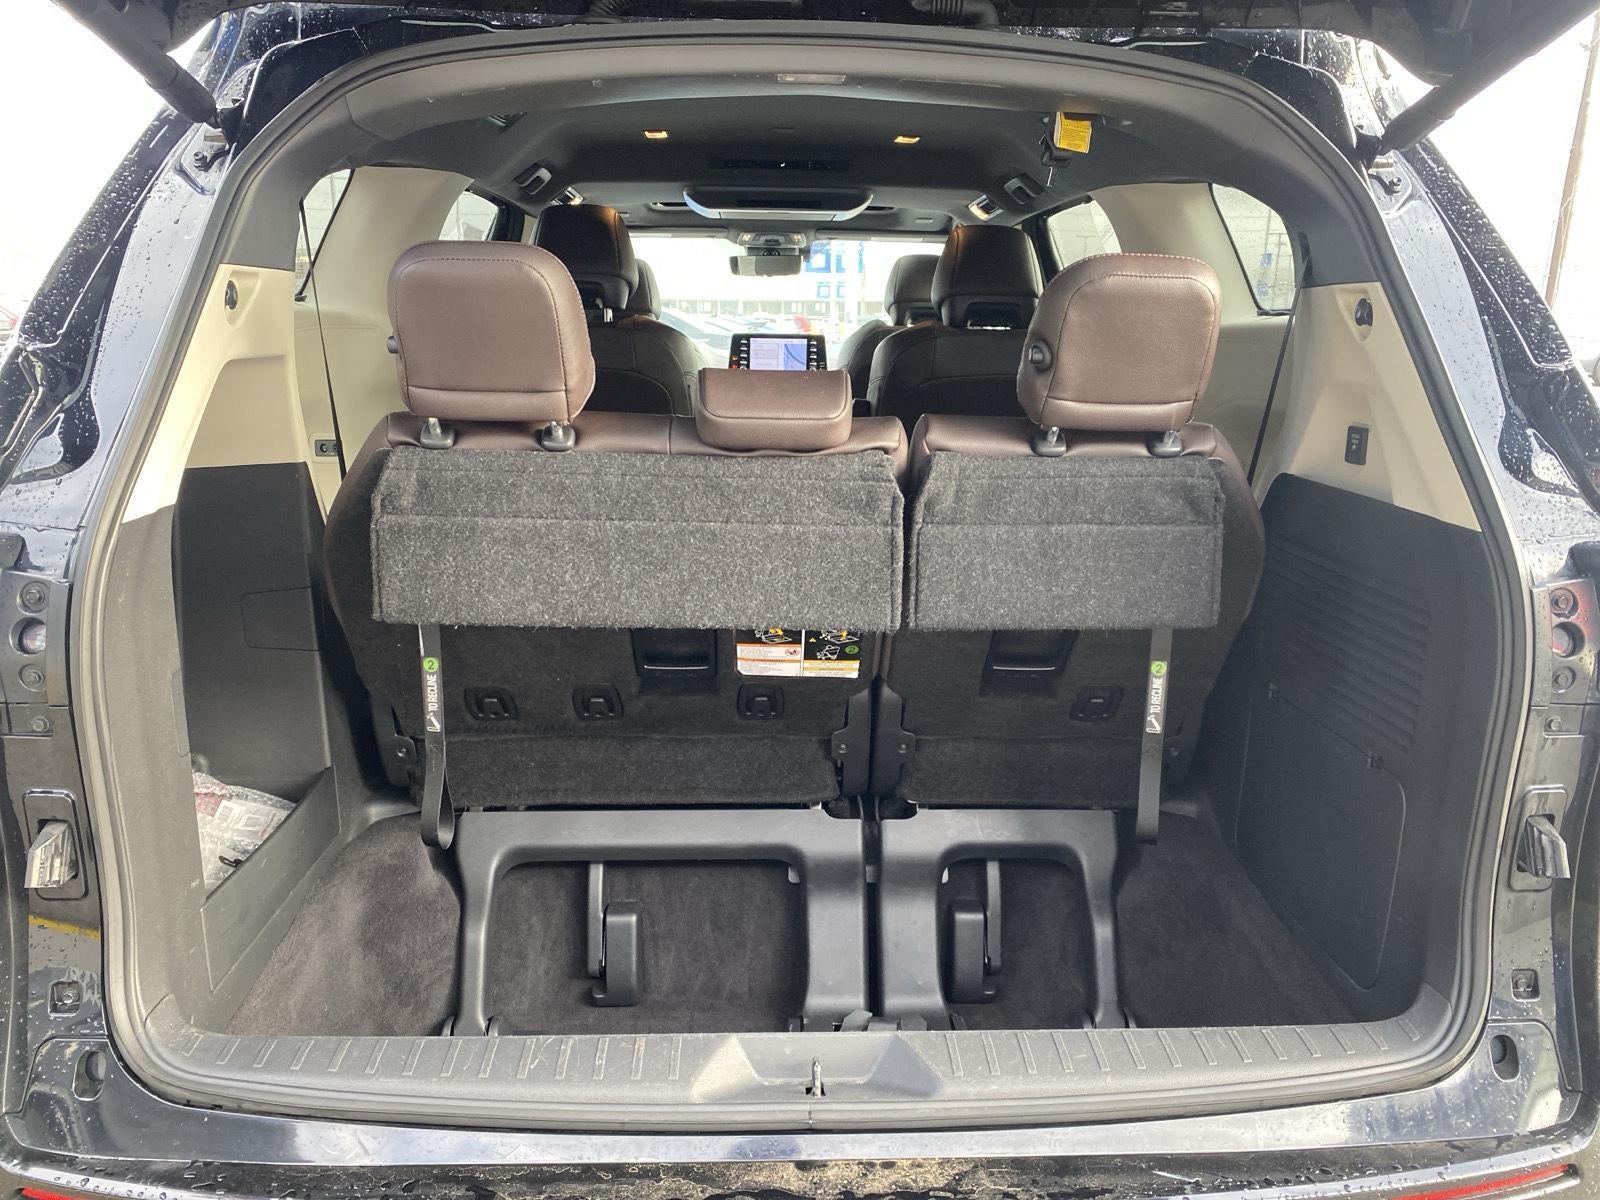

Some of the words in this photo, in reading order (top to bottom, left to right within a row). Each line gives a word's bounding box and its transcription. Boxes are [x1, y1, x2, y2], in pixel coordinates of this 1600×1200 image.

[427, 659, 435, 670] 2
[1155, 663, 1163, 673] 2
[427, 674, 438, 703] RECLINE
[1151, 677, 1163, 705] RECLINE
[428, 703, 438, 711] TO
[1150, 705, 1161, 713] TO
